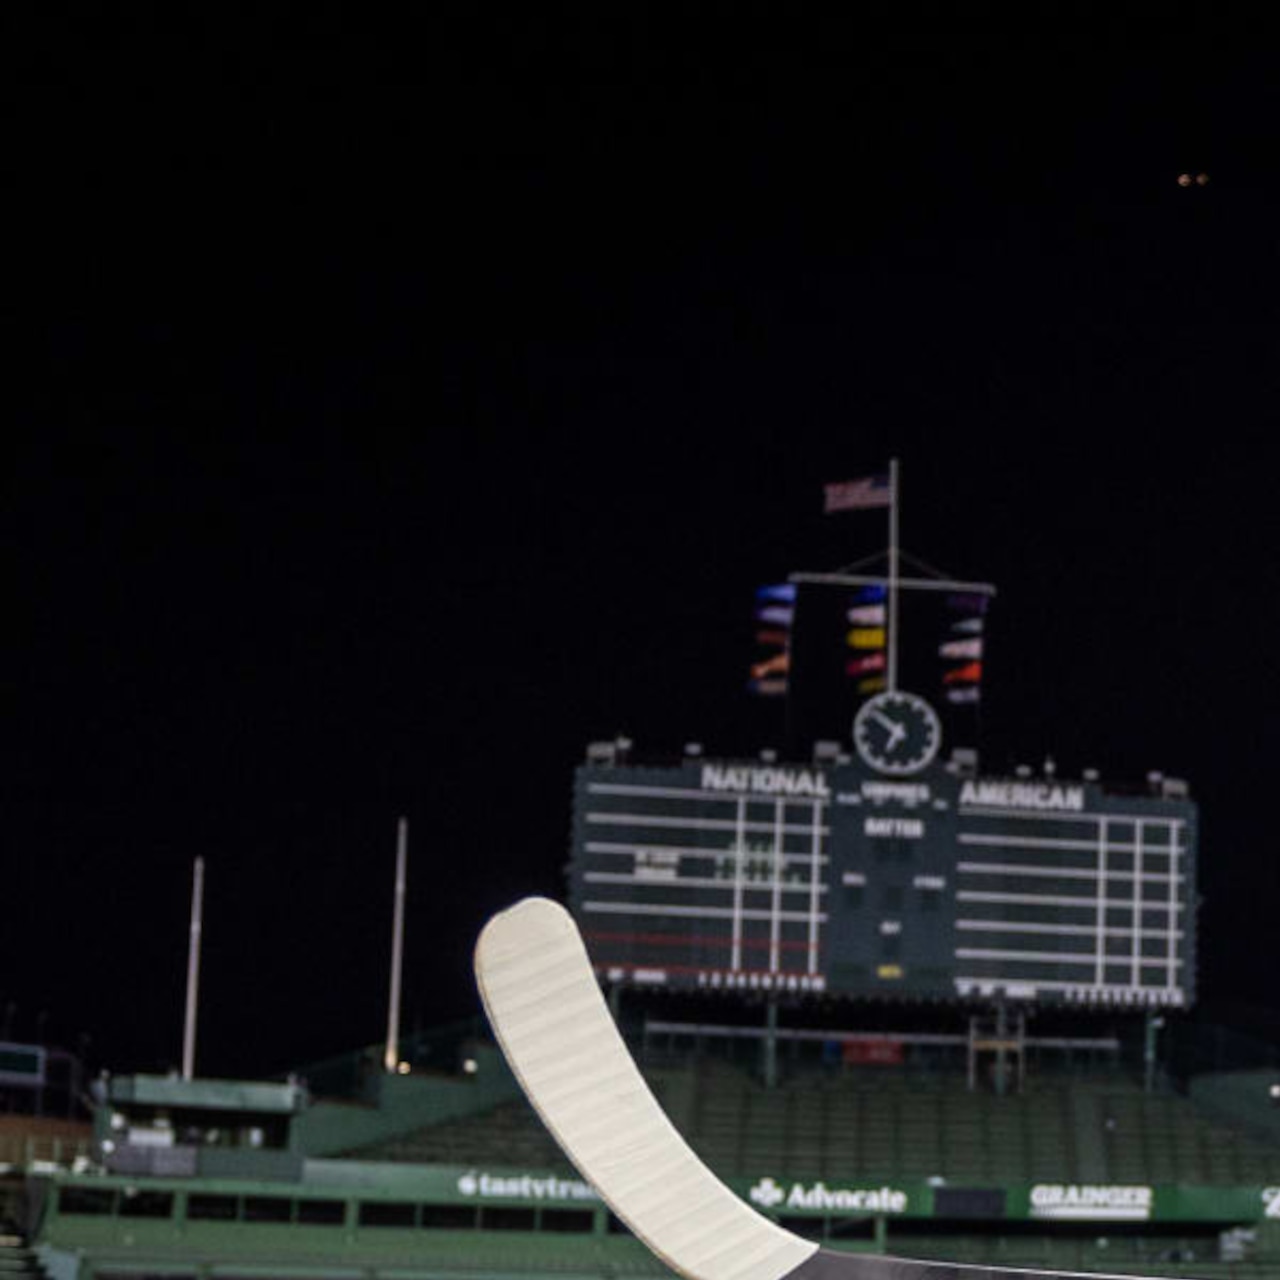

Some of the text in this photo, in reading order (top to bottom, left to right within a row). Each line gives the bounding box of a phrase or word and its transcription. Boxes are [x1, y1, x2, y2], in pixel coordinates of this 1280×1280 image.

[701, 763, 831, 796] NATIONAL
[960, 779, 1084, 811] AMERICAN
[479, 1172, 600, 1200] tastytra
[786, 1182, 908, 1213] Advocate
[1030, 1184, 1153, 1207] GRAINGER
